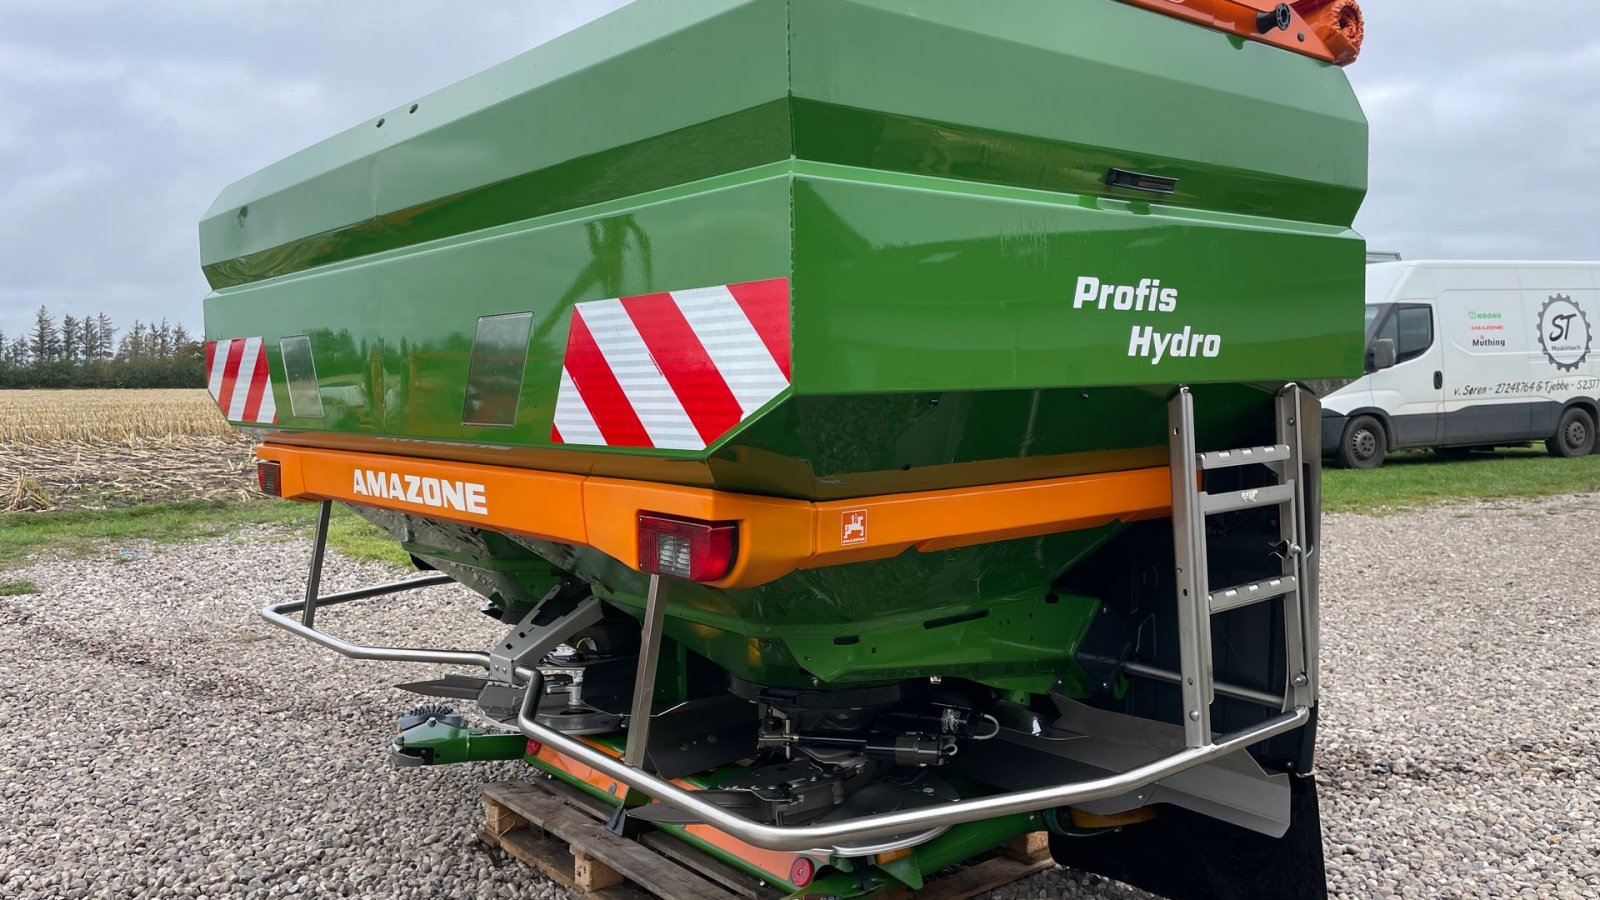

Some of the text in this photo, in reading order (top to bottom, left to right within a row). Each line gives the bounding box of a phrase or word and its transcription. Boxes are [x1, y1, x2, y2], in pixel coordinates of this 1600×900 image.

[1073, 276, 1178, 312] Profis
[1127, 325, 1221, 365] Hydro
[1549, 313, 1577, 341] ST
[1462, 384, 1487, 396] Søren
[1544, 379, 1569, 394] Tjebbe
[353, 468, 488, 515] AMAZONE
